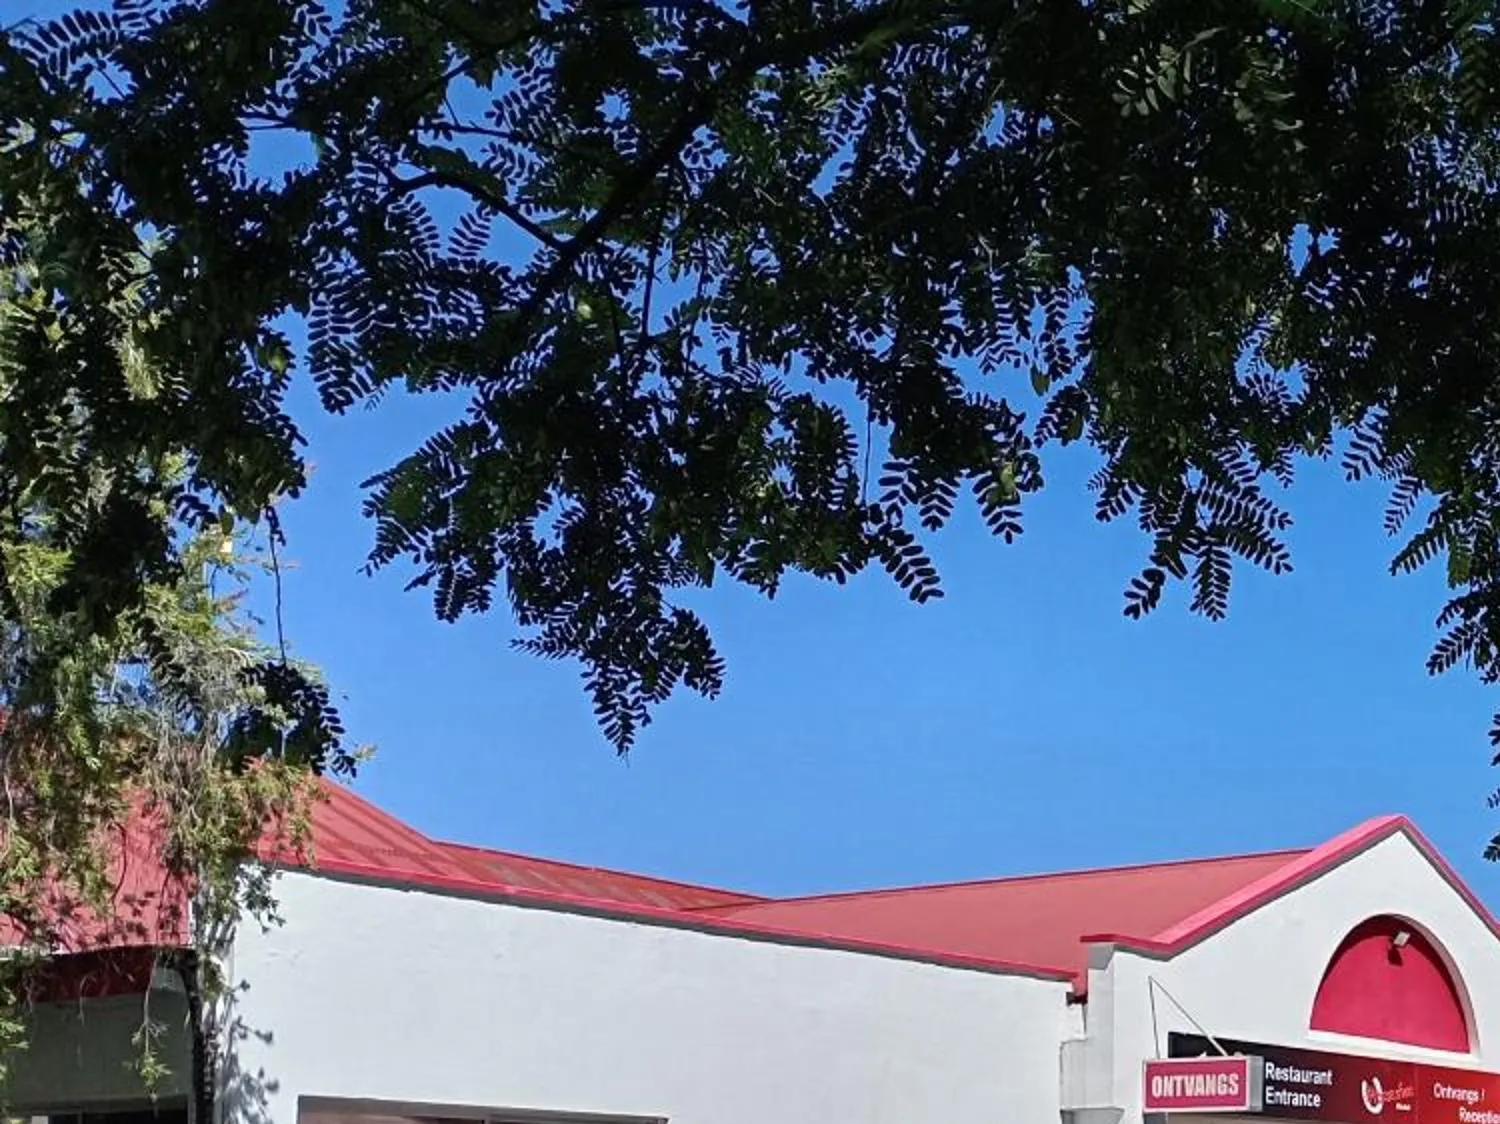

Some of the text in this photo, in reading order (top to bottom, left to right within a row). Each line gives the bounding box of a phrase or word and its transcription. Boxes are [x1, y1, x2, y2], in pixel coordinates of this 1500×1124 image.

[1152, 1073, 1239, 1098] ONTVANGS
[1265, 1062, 1333, 1086] Restaurant
[1265, 1086, 1321, 1107] Entrance
[1433, 1083, 1479, 1105] Ontvangs
